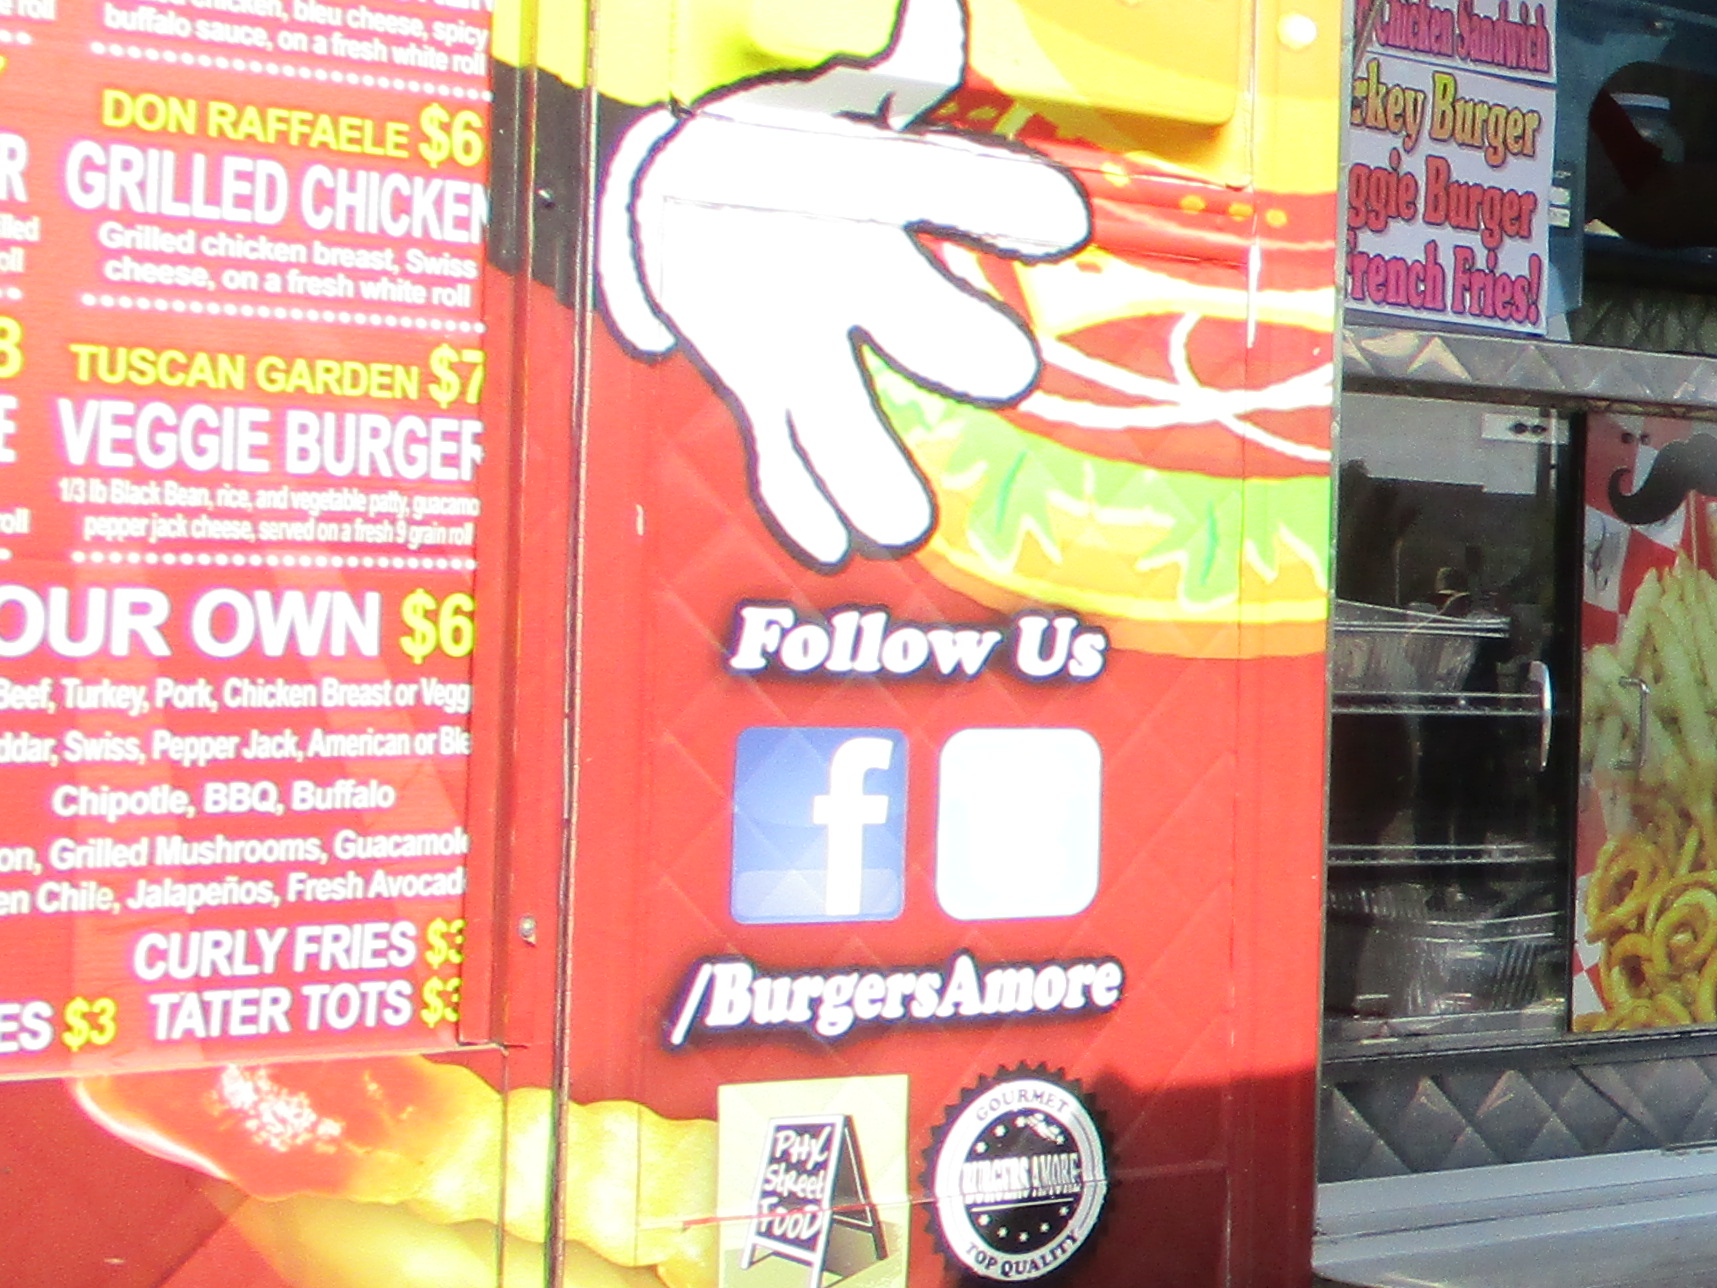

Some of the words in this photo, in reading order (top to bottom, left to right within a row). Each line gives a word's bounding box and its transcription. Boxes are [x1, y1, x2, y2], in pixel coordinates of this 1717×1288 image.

[102, 88, 196, 135] DON
[206, 100, 410, 158] RAFFAELE
[418, 102, 483, 168] $6
[1352, 57, 1427, 153] rkey
[1431, 71, 1541, 168] Burger
[65, 139, 288, 224] GRILLED
[301, 164, 491, 244] CHICKEN
[1348, 147, 1419, 233] ggie
[1423, 154, 1537, 249] Burger
[99, 222, 196, 254] Grilled
[201, 231, 313, 263] chicken
[314, 241, 400, 273] breast,
[405, 246, 478, 279] Swiss
[104, 256, 215, 290] cheese,
[286, 267, 353, 297] fresh
[358, 275, 427, 302] white
[431, 279, 471, 307] roll
[1452, 245, 1542, 326] Fries!
[69, 342, 247, 390] TUSCAN
[255, 355, 419, 400] GARDEN
[429, 344, 485, 409] $7
[57, 396, 270, 472] VEGGIE
[0, 585, 173, 658] OUR
[191, 588, 381, 658] OWN
[400, 589, 474, 665] $6
[730, 606, 1000, 678] Follow
[1016, 615, 1106, 678] Us
[61, 677, 149, 716] Turkey,
[156, 678, 219, 712] Pork,
[223, 677, 316, 707] Chicken
[321, 678, 392, 707] Breast
[63, 730, 146, 764] Swiss,
[152, 730, 240, 766] Pepper
[243, 729, 304, 762] Jack,
[307, 727, 409, 757] American
[52, 784, 196, 822] Chipotle,
[203, 783, 284, 816] BBQ,
[290, 780, 396, 810] Buffalo
[812, 737, 892, 915] f
[50, 837, 148, 869] Grilled
[154, 833, 328, 867] Mushrooms,
[37, 881, 121, 914] Chile,
[126, 875, 281, 913] Jalapeños,
[286, 871, 362, 902] Fresh
[369, 865, 466, 898] Avocad
[132, 928, 288, 981] CURLY
[292, 921, 416, 972] FRIES
[62, 996, 118, 1051] $3
[149, 987, 292, 1040] TATER
[301, 980, 412, 1032] TOTS
[671, 957, 1122, 1046] /BurgersAmore
[975, 1089, 1069, 1122] GOURMET
[775, 1126, 830, 1169] PHX
[963, 1156, 1029, 1206] BURGERS
[1032, 1153, 1081, 1196] AMORE
[966, 1243, 998, 1273] TOP
[1000, 1232, 1079, 1278] QUALITY
